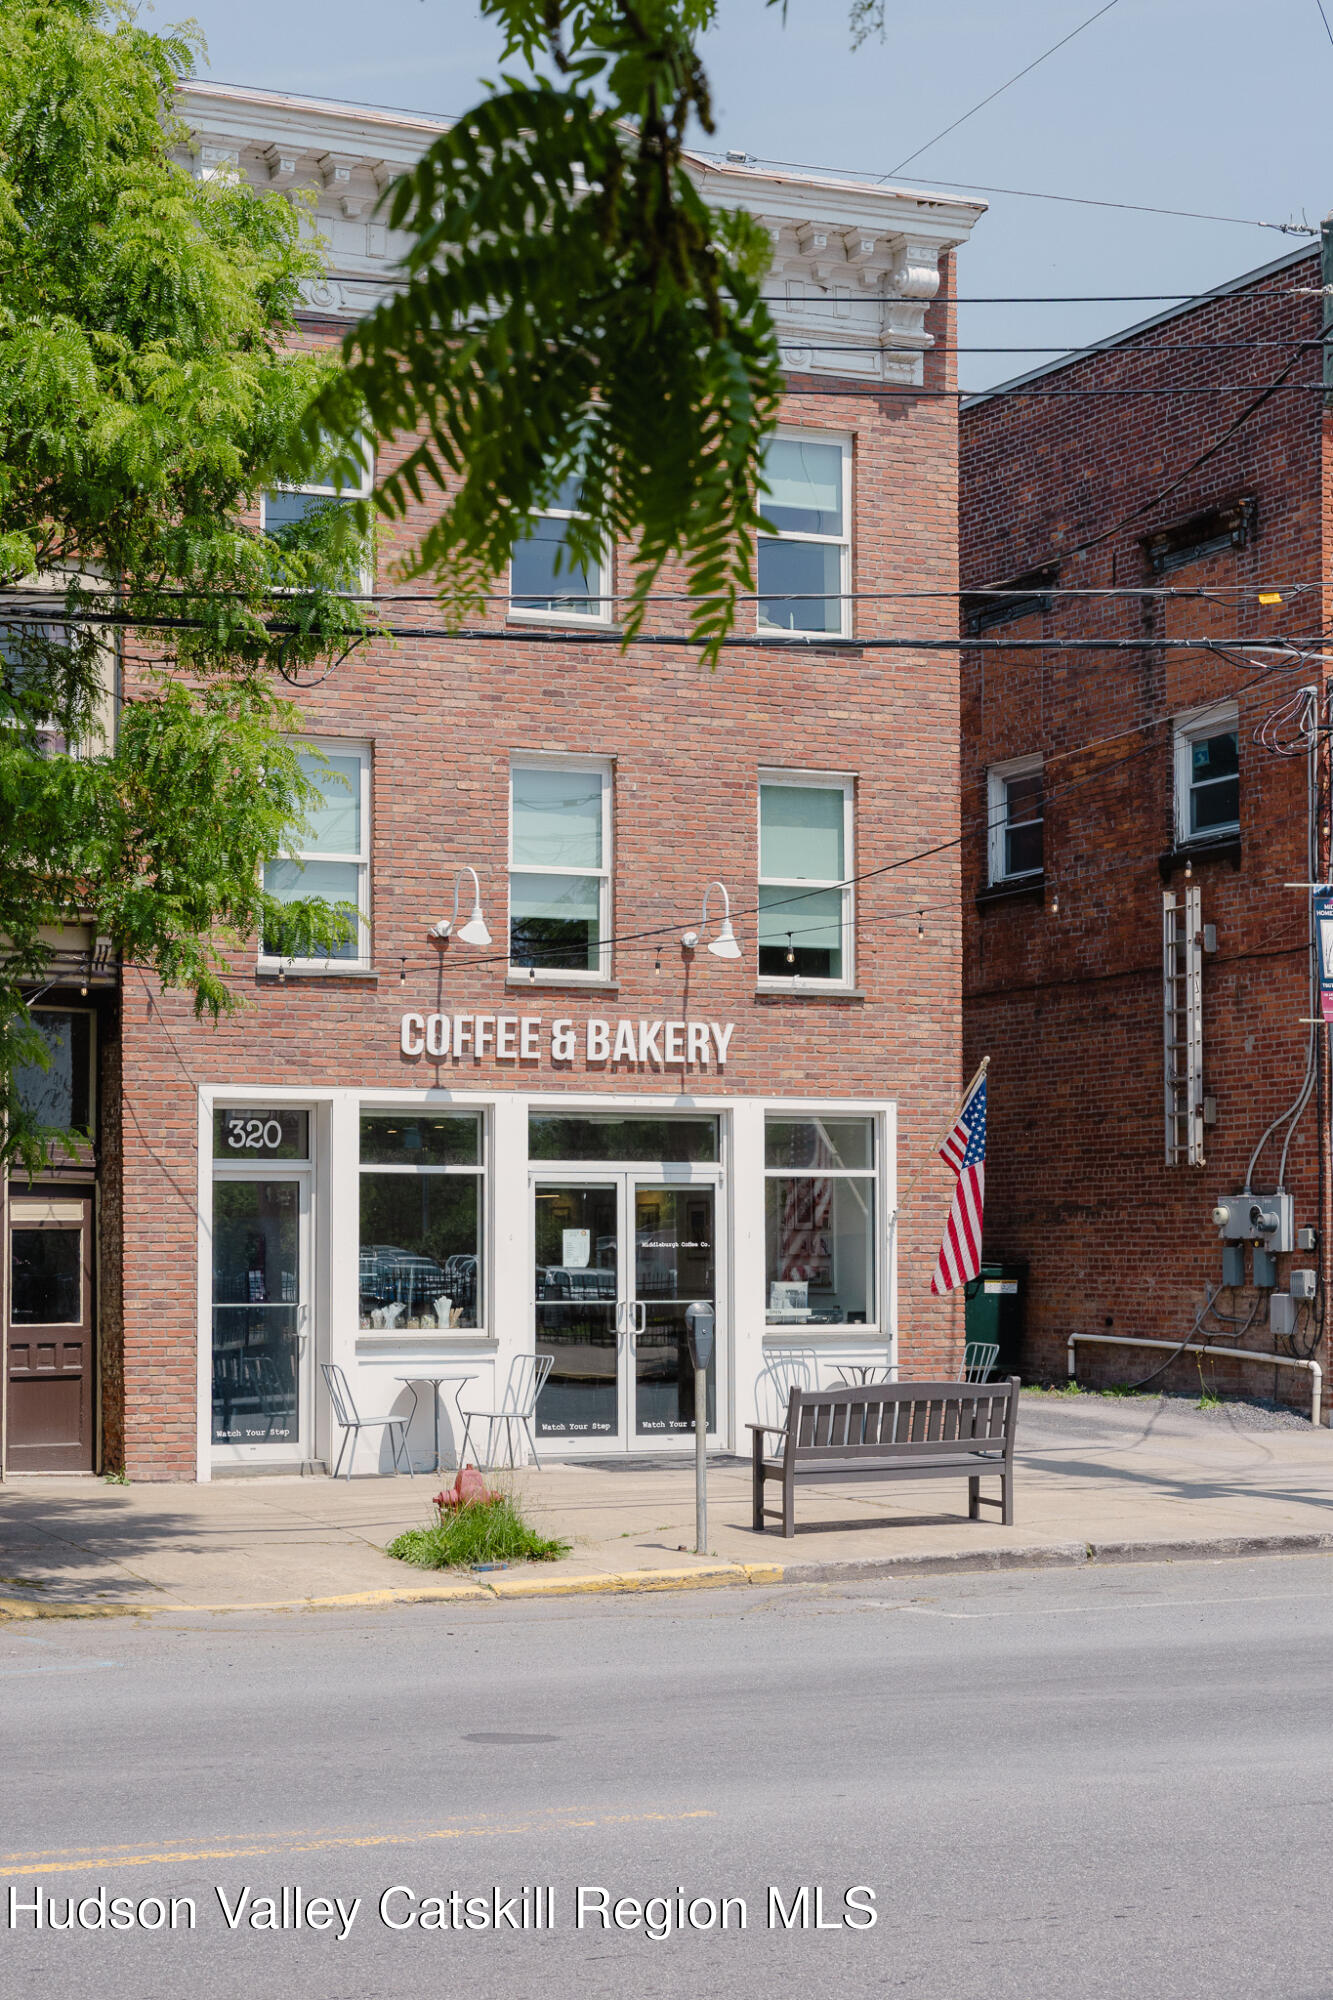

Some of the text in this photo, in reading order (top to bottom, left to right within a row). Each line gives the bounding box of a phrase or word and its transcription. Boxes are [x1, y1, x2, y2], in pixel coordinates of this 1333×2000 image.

[400, 1012, 735, 1064] COFFEE & BAKERY
[228, 1119, 282, 1148] 320
[592, 1422, 611, 1431] Step
[669, 1420, 688, 1428] Your
[245, 1429, 266, 1437] Your
[270, 1428, 290, 1437] Step
